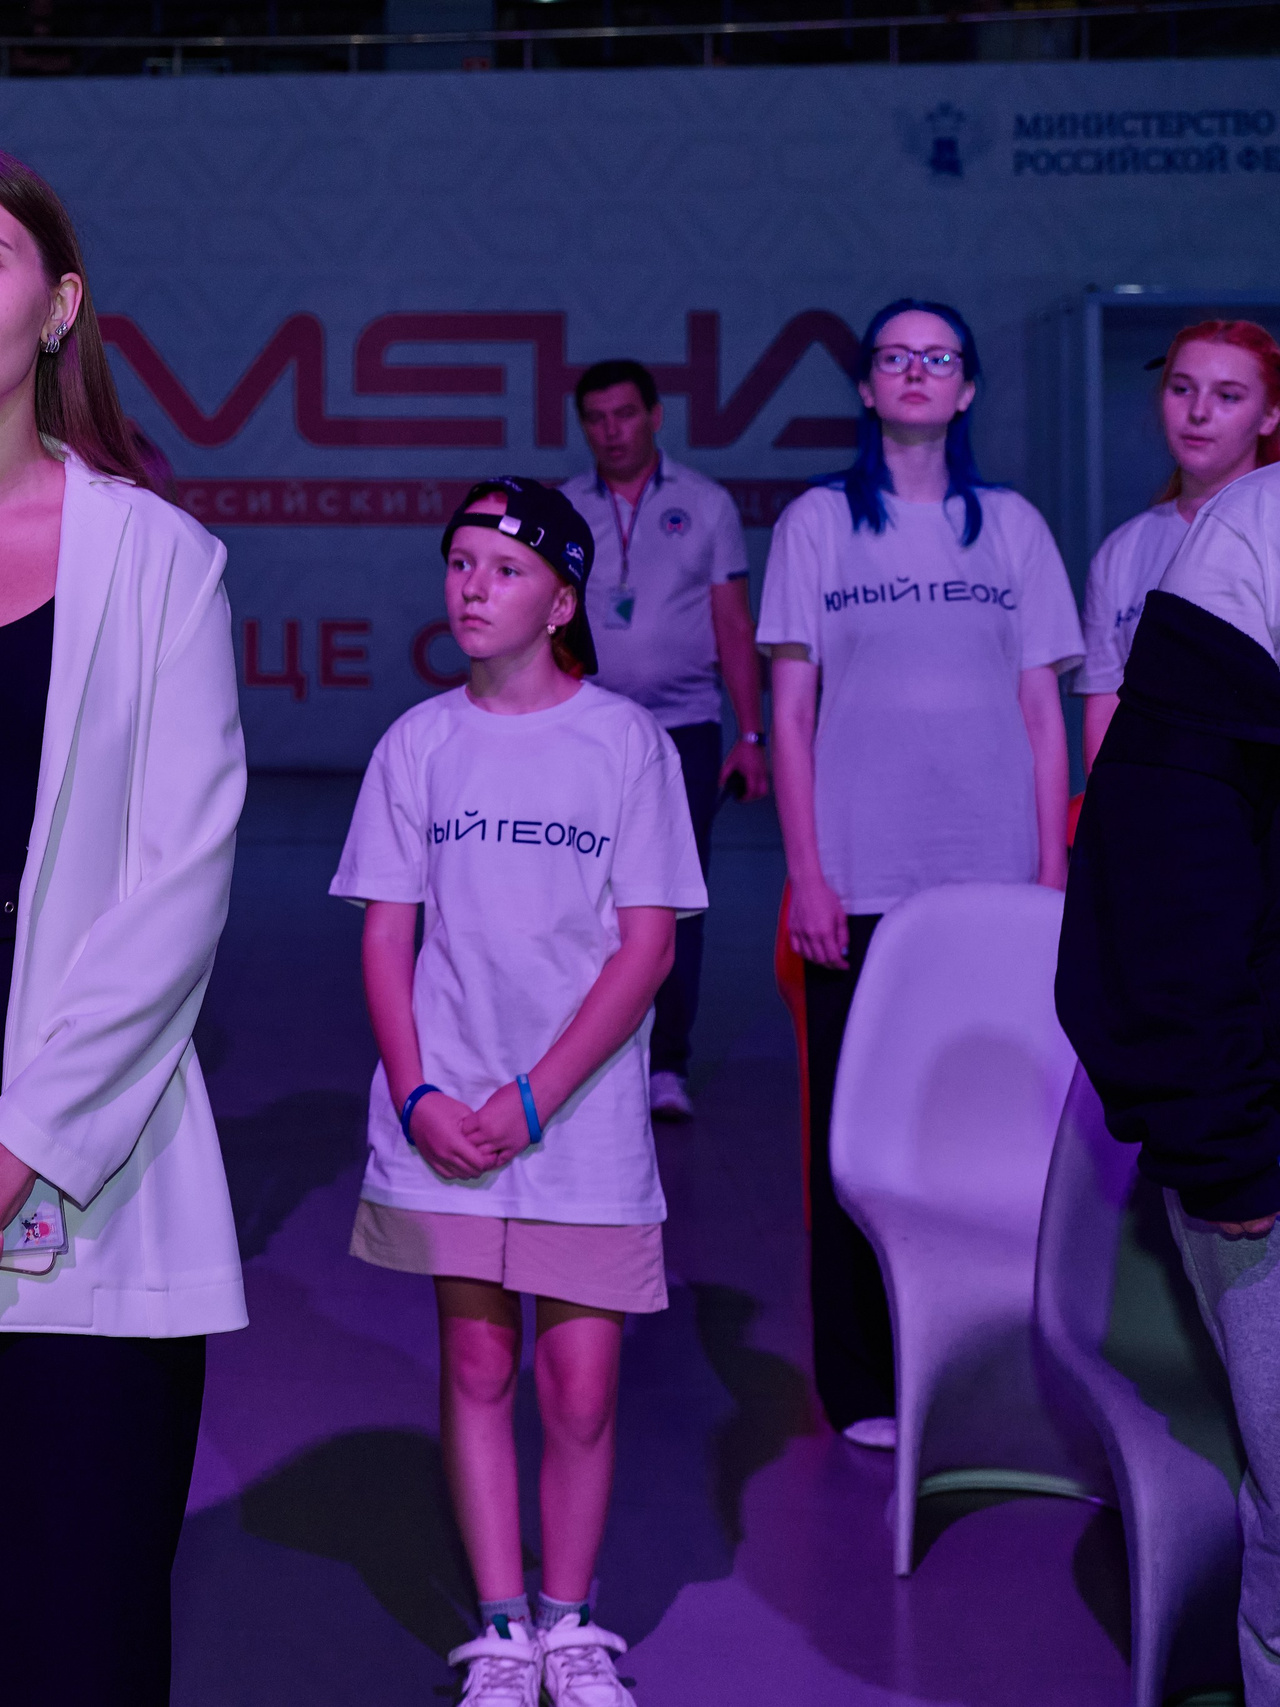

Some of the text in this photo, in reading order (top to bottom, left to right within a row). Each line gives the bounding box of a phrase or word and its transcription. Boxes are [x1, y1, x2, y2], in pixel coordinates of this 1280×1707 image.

[1013, 108, 1276, 140] МИНИСТЕРСТВО
[1013, 142, 1229, 175] РОССИЙСКОЙ
[96, 310, 864, 448] МЕНА
[183, 480, 445, 518] ССИЙСКИЙ
[824, 577, 920, 612] ЮНЫЙ
[242, 618, 370, 701] ЦЕ
[427, 810, 611, 858] ЫЙ ГЕОЛОГ
